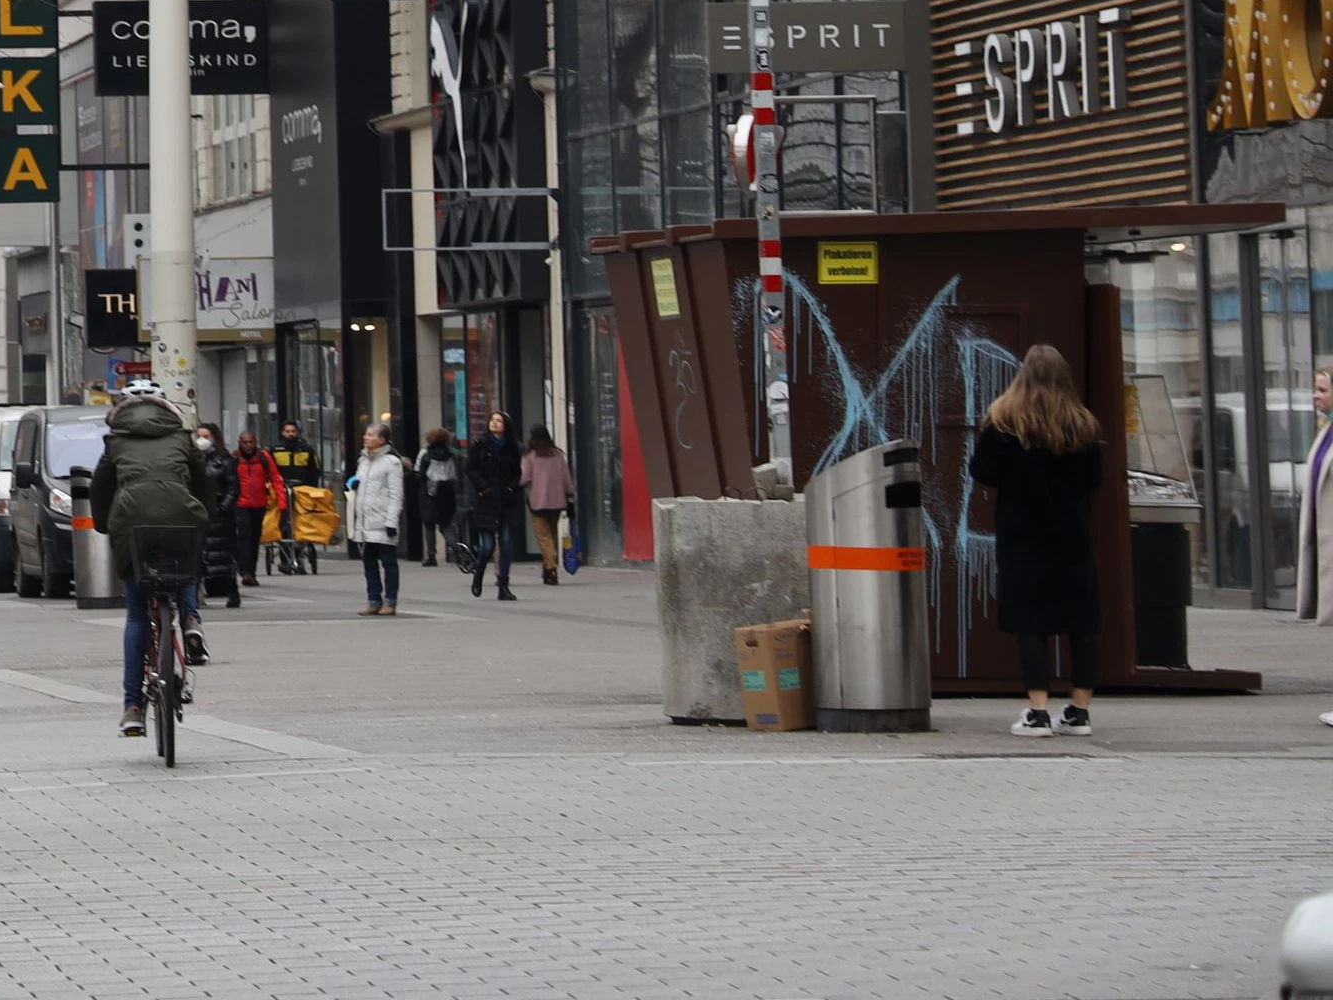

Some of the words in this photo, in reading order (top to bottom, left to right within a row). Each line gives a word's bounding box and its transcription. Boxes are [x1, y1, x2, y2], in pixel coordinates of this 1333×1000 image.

[111, 18, 256, 43] coma,
[112, 54, 257, 68] LIESKIND
[954, 8, 1130, 134] ESPRIT
